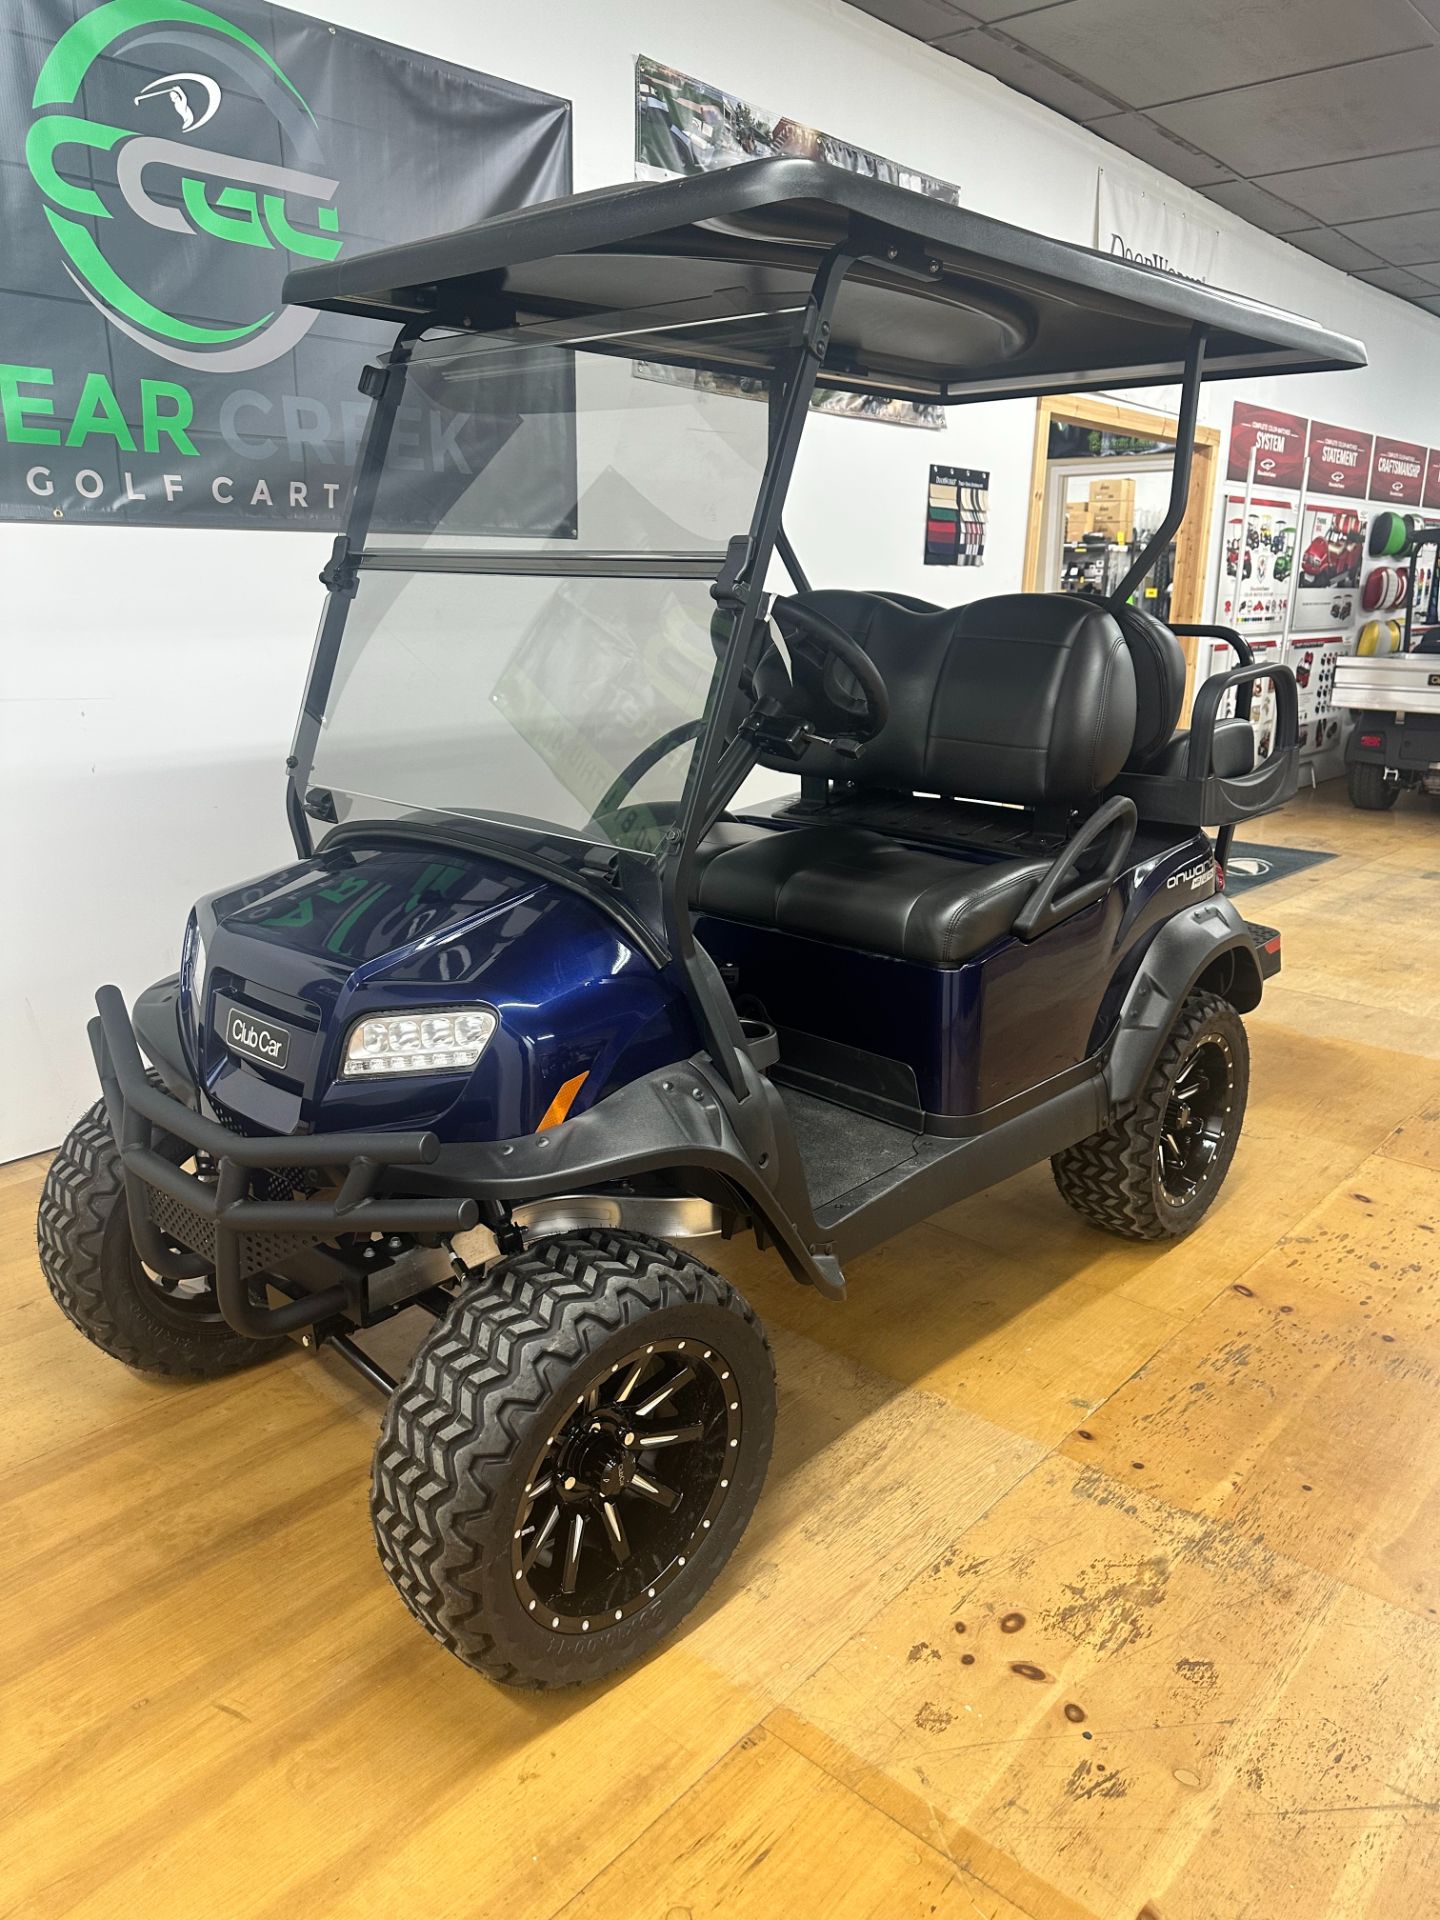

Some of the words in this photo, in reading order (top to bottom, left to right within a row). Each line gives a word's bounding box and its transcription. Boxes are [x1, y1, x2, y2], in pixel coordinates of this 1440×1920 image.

[0, 364, 200, 456] EAR
[1256, 431, 1285, 453] SYSTEM
[1322, 446, 1358, 467] STATEMENT
[1378, 457, 1420, 478] CRAFTSMANSHIP
[26, 466, 183, 501] GOLF
[211, 476, 358, 509] CART
[232, 1019, 258, 1048] Club
[259, 1031, 282, 1058] Car
